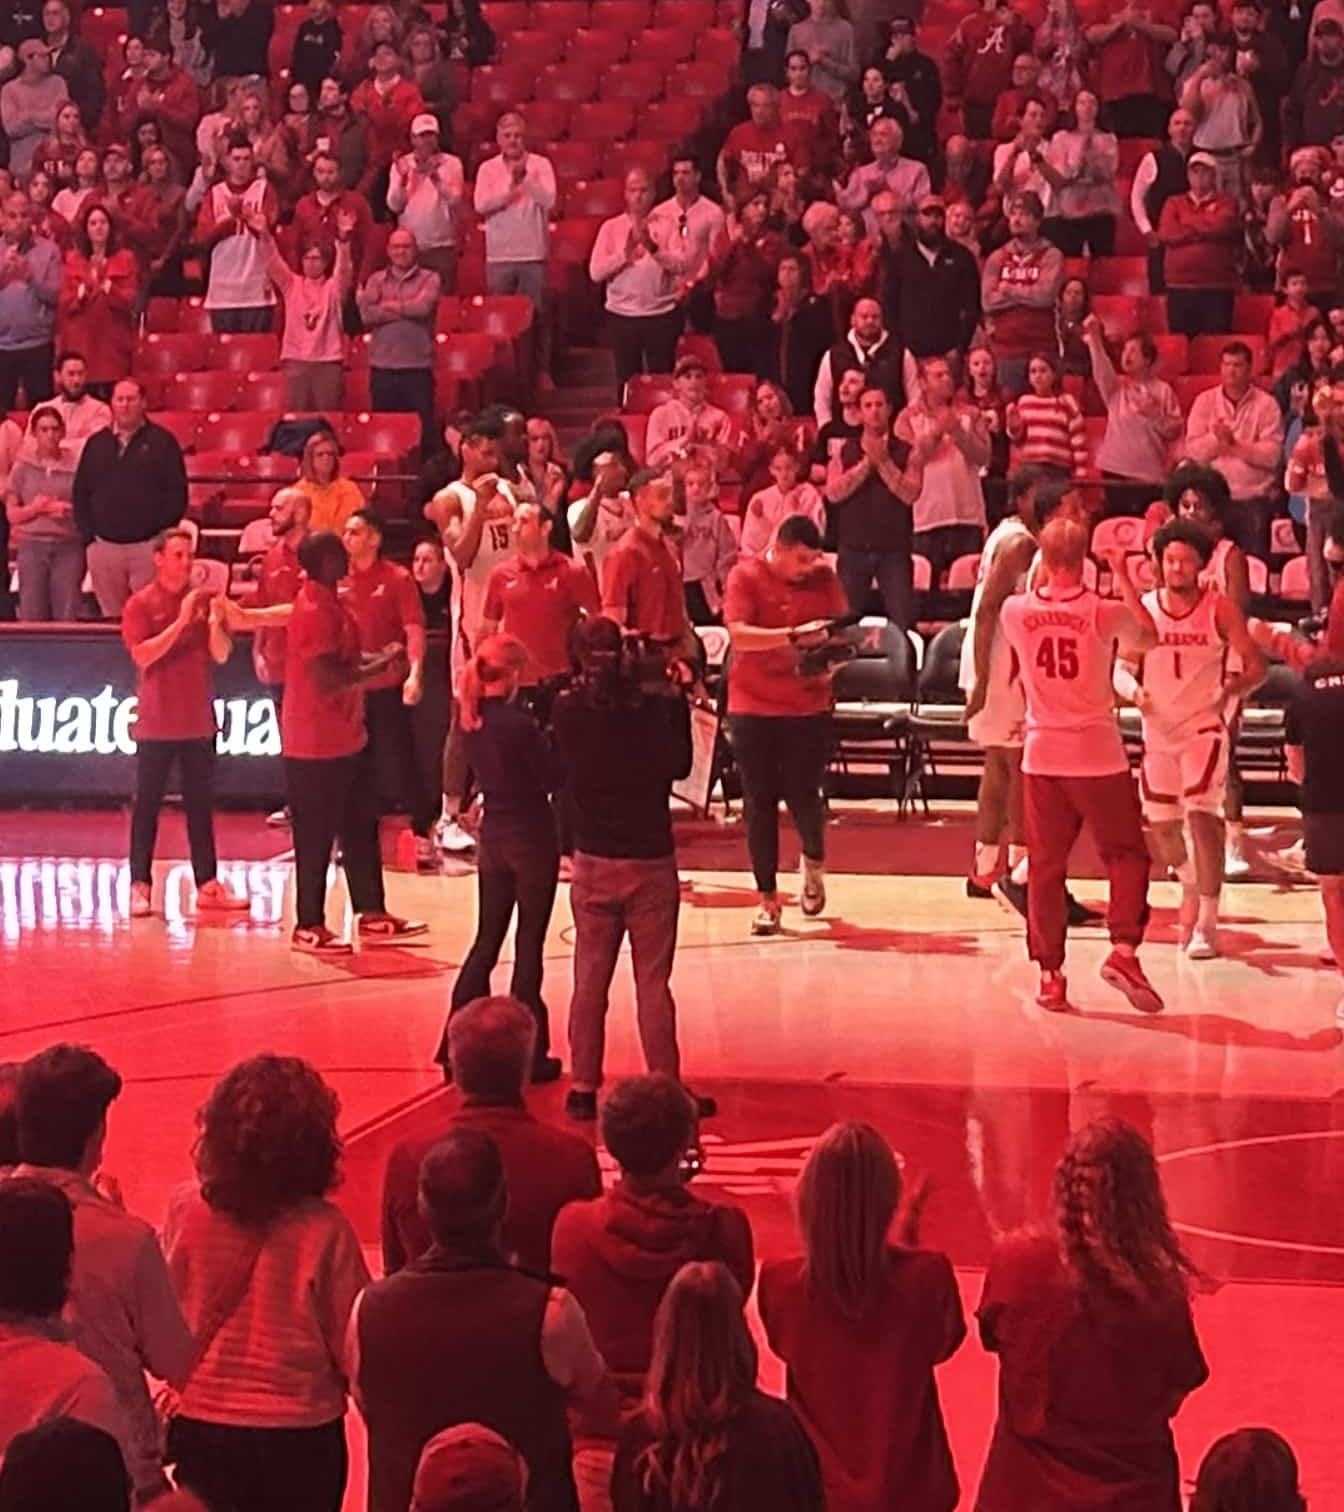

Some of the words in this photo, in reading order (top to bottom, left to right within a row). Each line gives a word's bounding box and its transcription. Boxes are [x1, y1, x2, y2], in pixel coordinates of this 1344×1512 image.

[490, 524, 509, 551] 15
[1158, 631, 1208, 647] LABAMA
[1036, 636, 1080, 679] 45
[1173, 650, 1182, 679] 1
